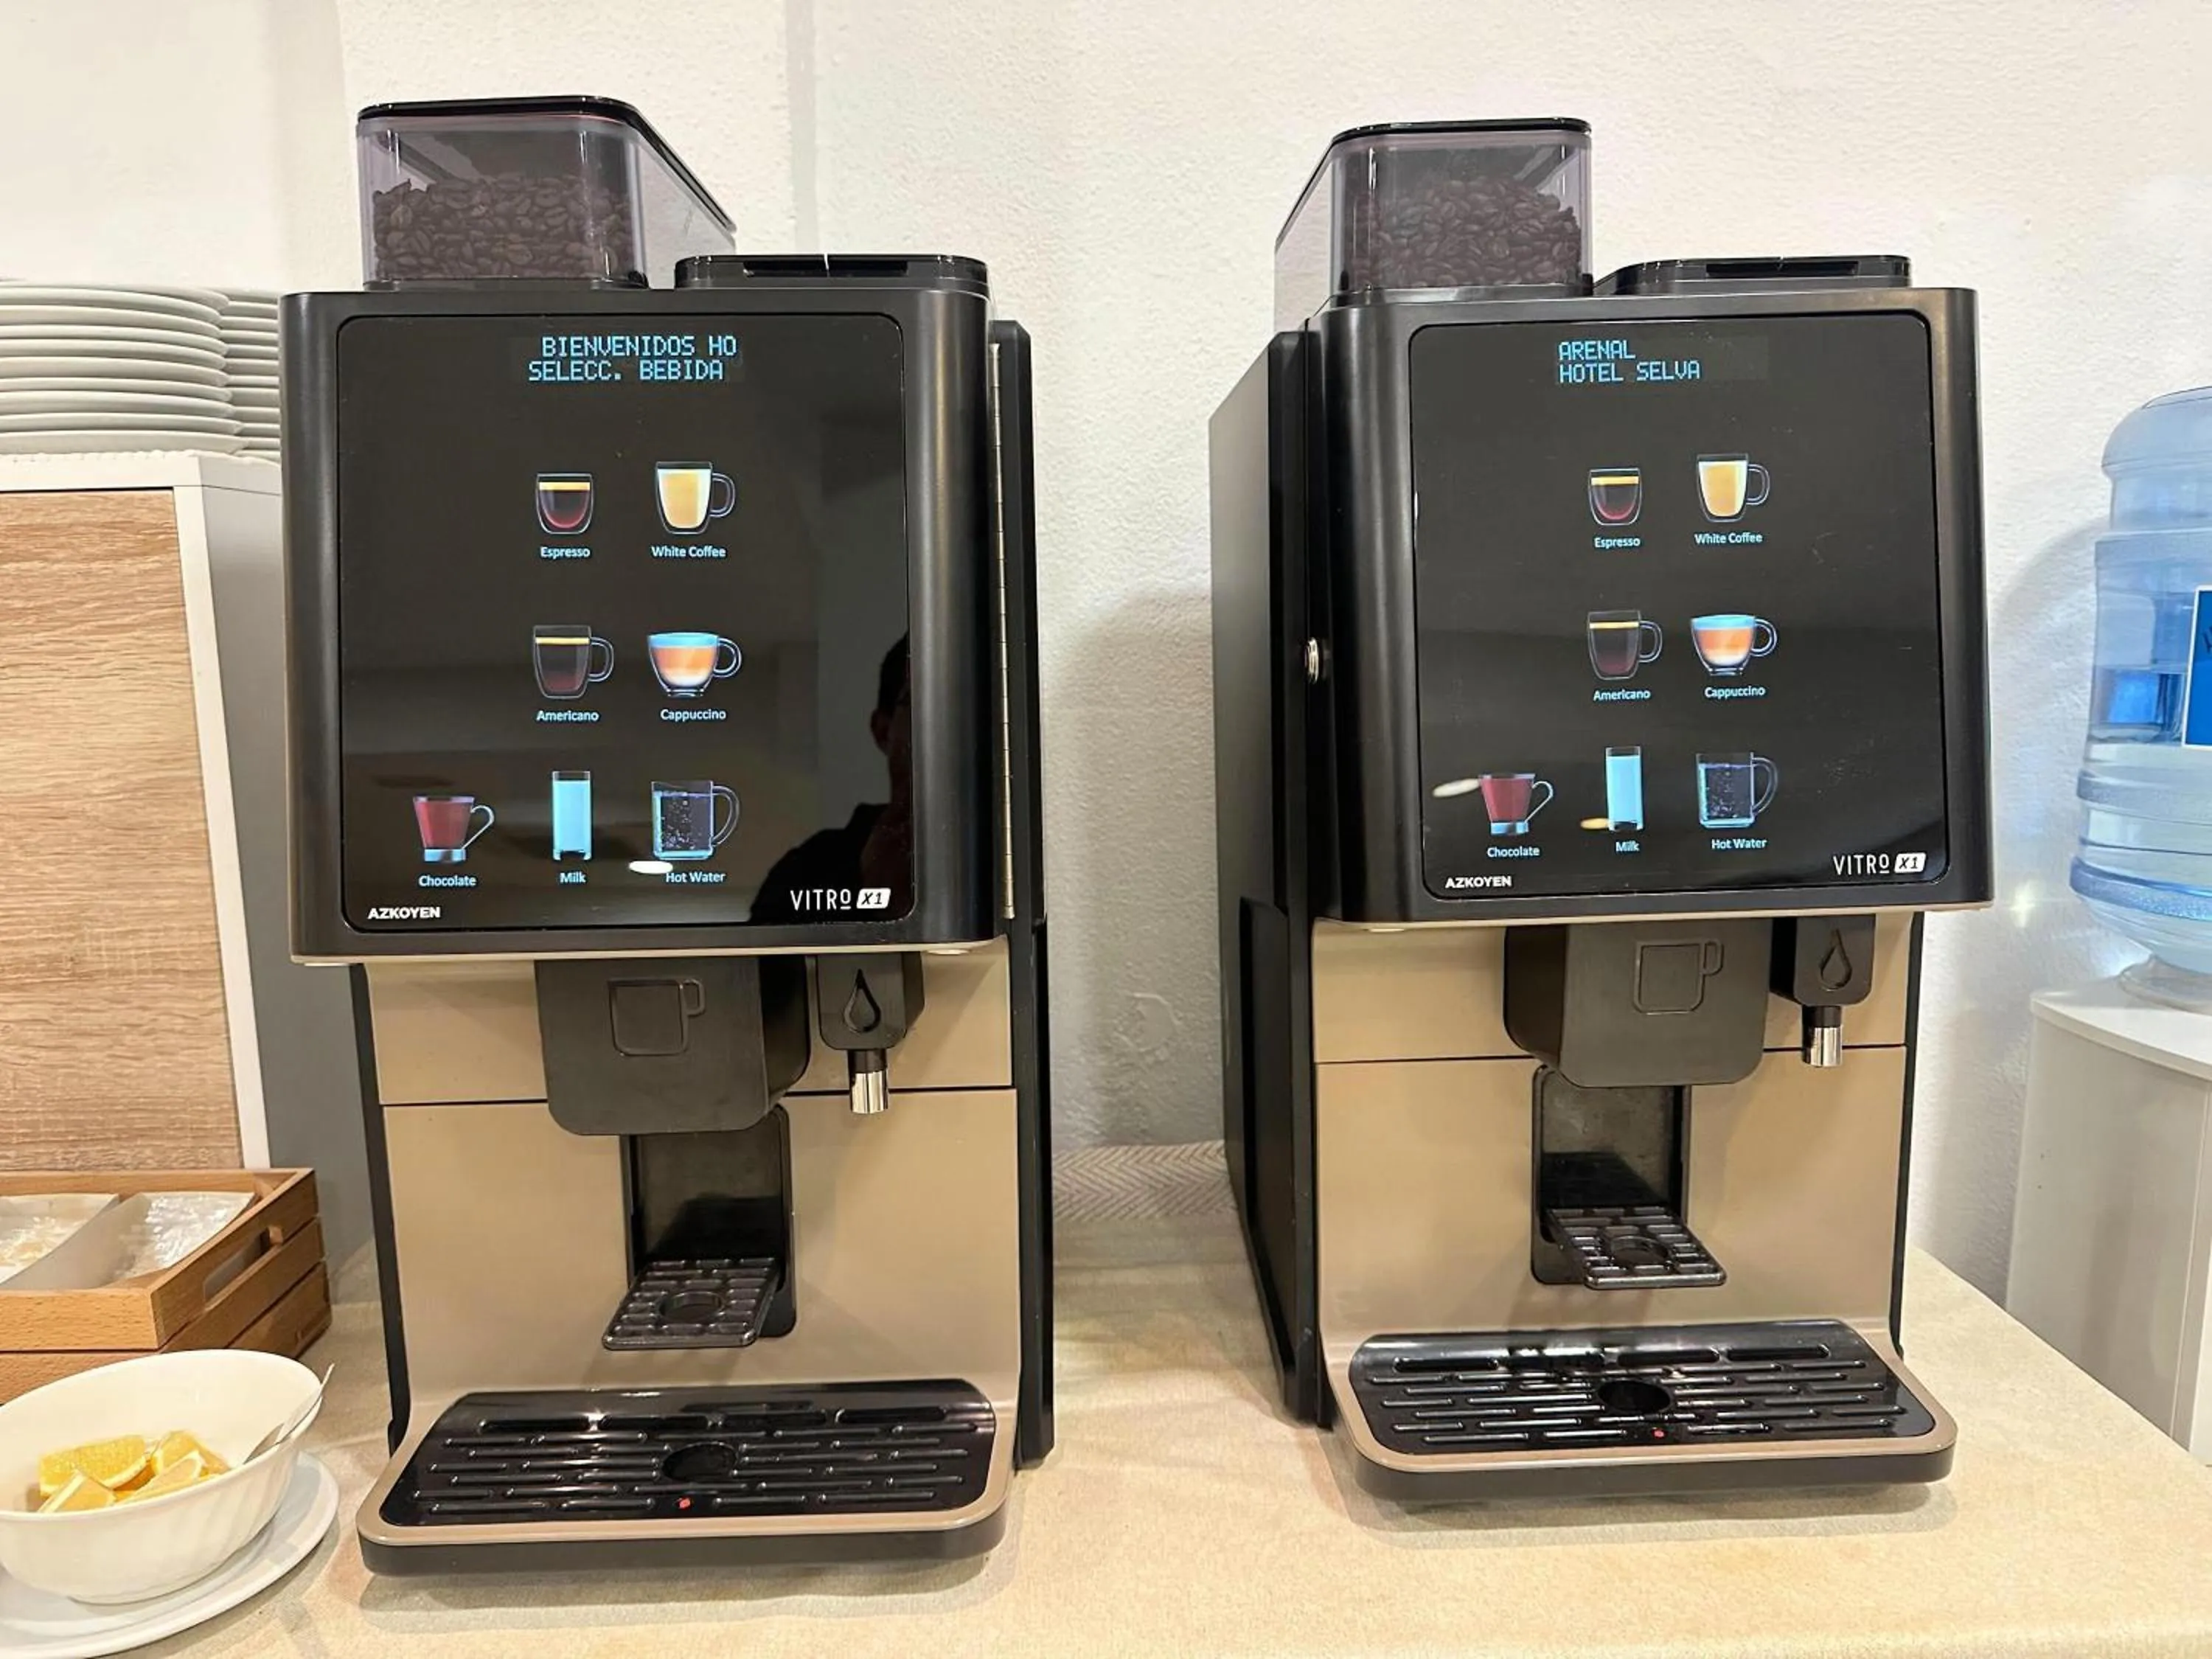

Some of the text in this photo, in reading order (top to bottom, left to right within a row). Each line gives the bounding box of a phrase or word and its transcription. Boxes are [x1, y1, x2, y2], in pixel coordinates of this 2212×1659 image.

[542, 335, 737, 357] BIENVENIDOS HO
[1558, 340, 1635, 360] ARENAL
[529, 359, 723, 380] SELECC. BEBIDA
[1559, 360, 1700, 383] HOTEL SELVA
[1594, 538, 1641, 549] Espresso
[1694, 532, 1762, 544] White Coffee
[540, 546, 590, 559] Espresso
[652, 546, 726, 557] White Coffee
[1593, 689, 1651, 700] Americano
[1705, 686, 1766, 700] Cappuccino
[536, 710, 599, 722] Americano
[661, 709, 726, 722] Cappuccino
[1615, 841, 1640, 852] Milk
[1711, 838, 1767, 849] Hot Water
[1487, 846, 1540, 858] Chocolate
[418, 875, 477, 886] Chocolate
[560, 872, 586, 883] Milk
[666, 872, 726, 883] Hot Water
[1445, 876, 1512, 888] AZKOYEN
[368, 906, 440, 919] AZKOYEN
